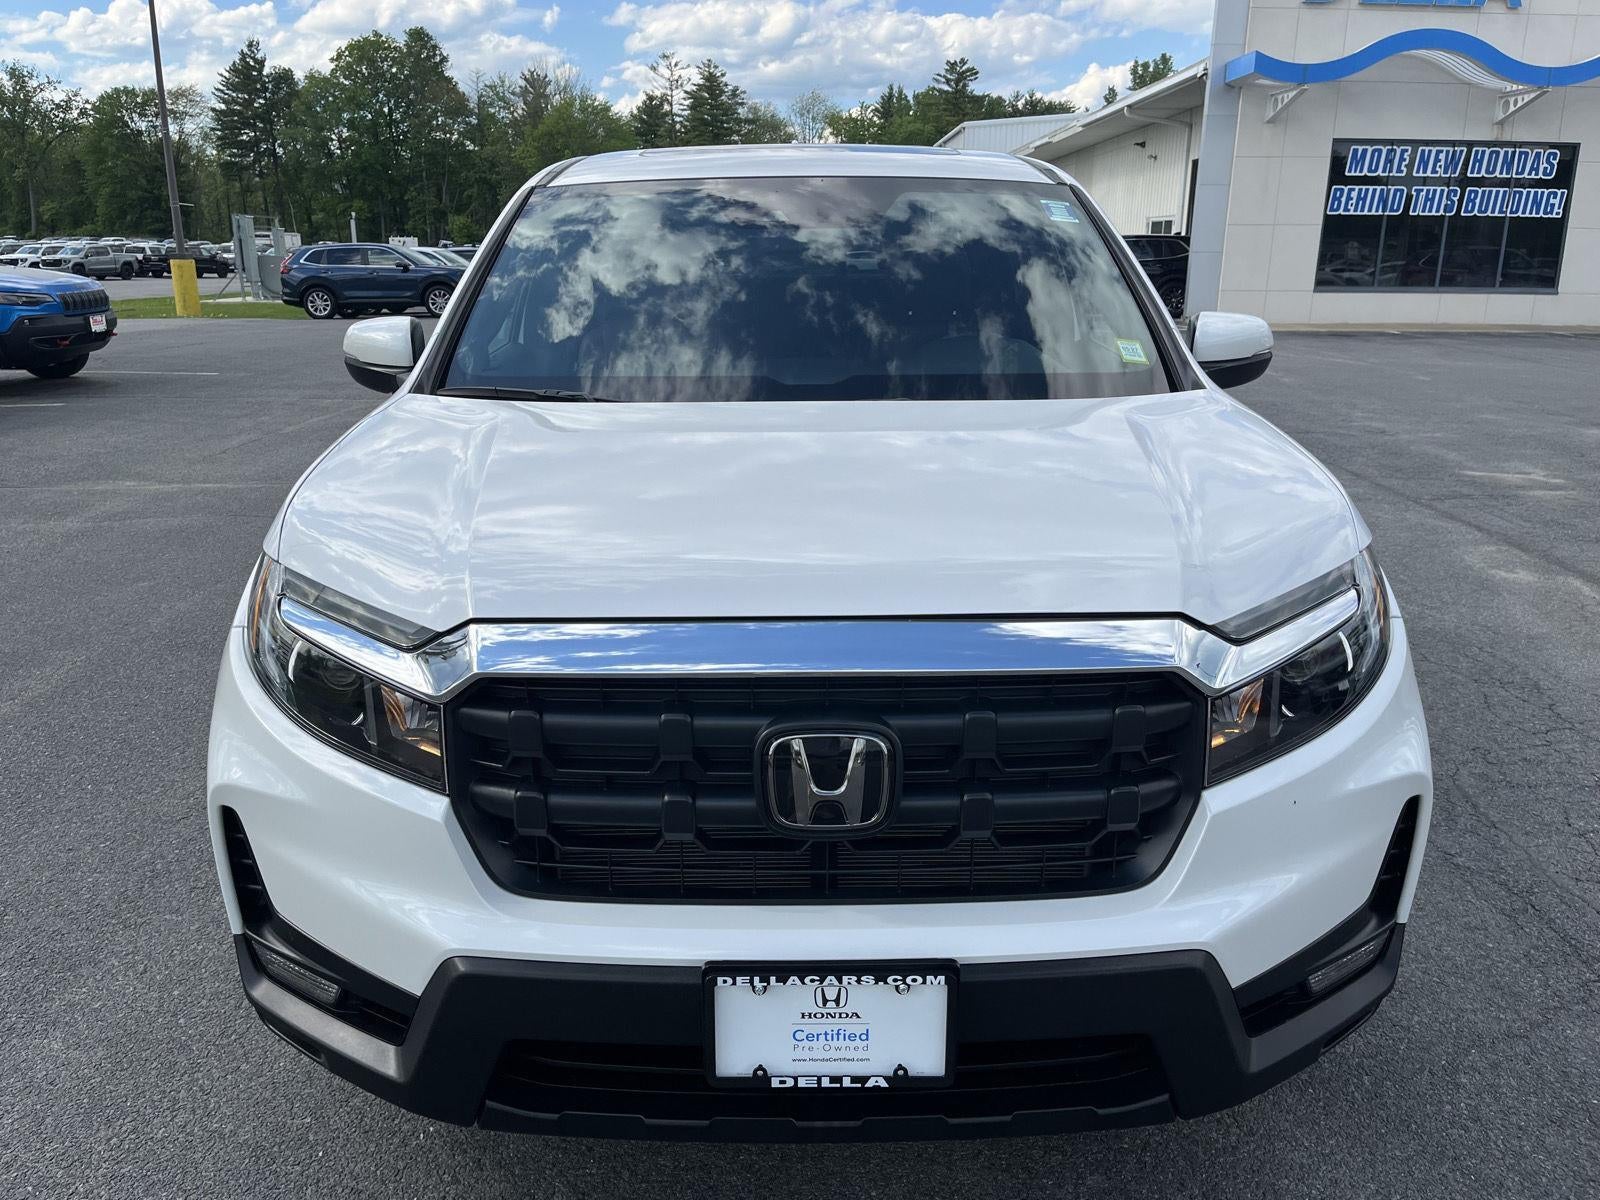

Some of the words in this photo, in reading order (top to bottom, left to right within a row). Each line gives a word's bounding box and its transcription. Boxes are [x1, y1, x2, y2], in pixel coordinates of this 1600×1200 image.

[1346, 146, 1411, 176] MORE
[1414, 147, 1466, 177] NEW
[1468, 147, 1560, 179] HONDAS
[1327, 186, 1406, 215] BEHIND
[1410, 187, 1460, 216] THIS
[1461, 188, 1567, 218] BUILDING!
[716, 975, 946, 986] DELLACARS.COM
[792, 1028, 870, 1042] Certified
[793, 1043, 869, 1052] Pre-Owned
[771, 1076, 889, 1088] DELLA
